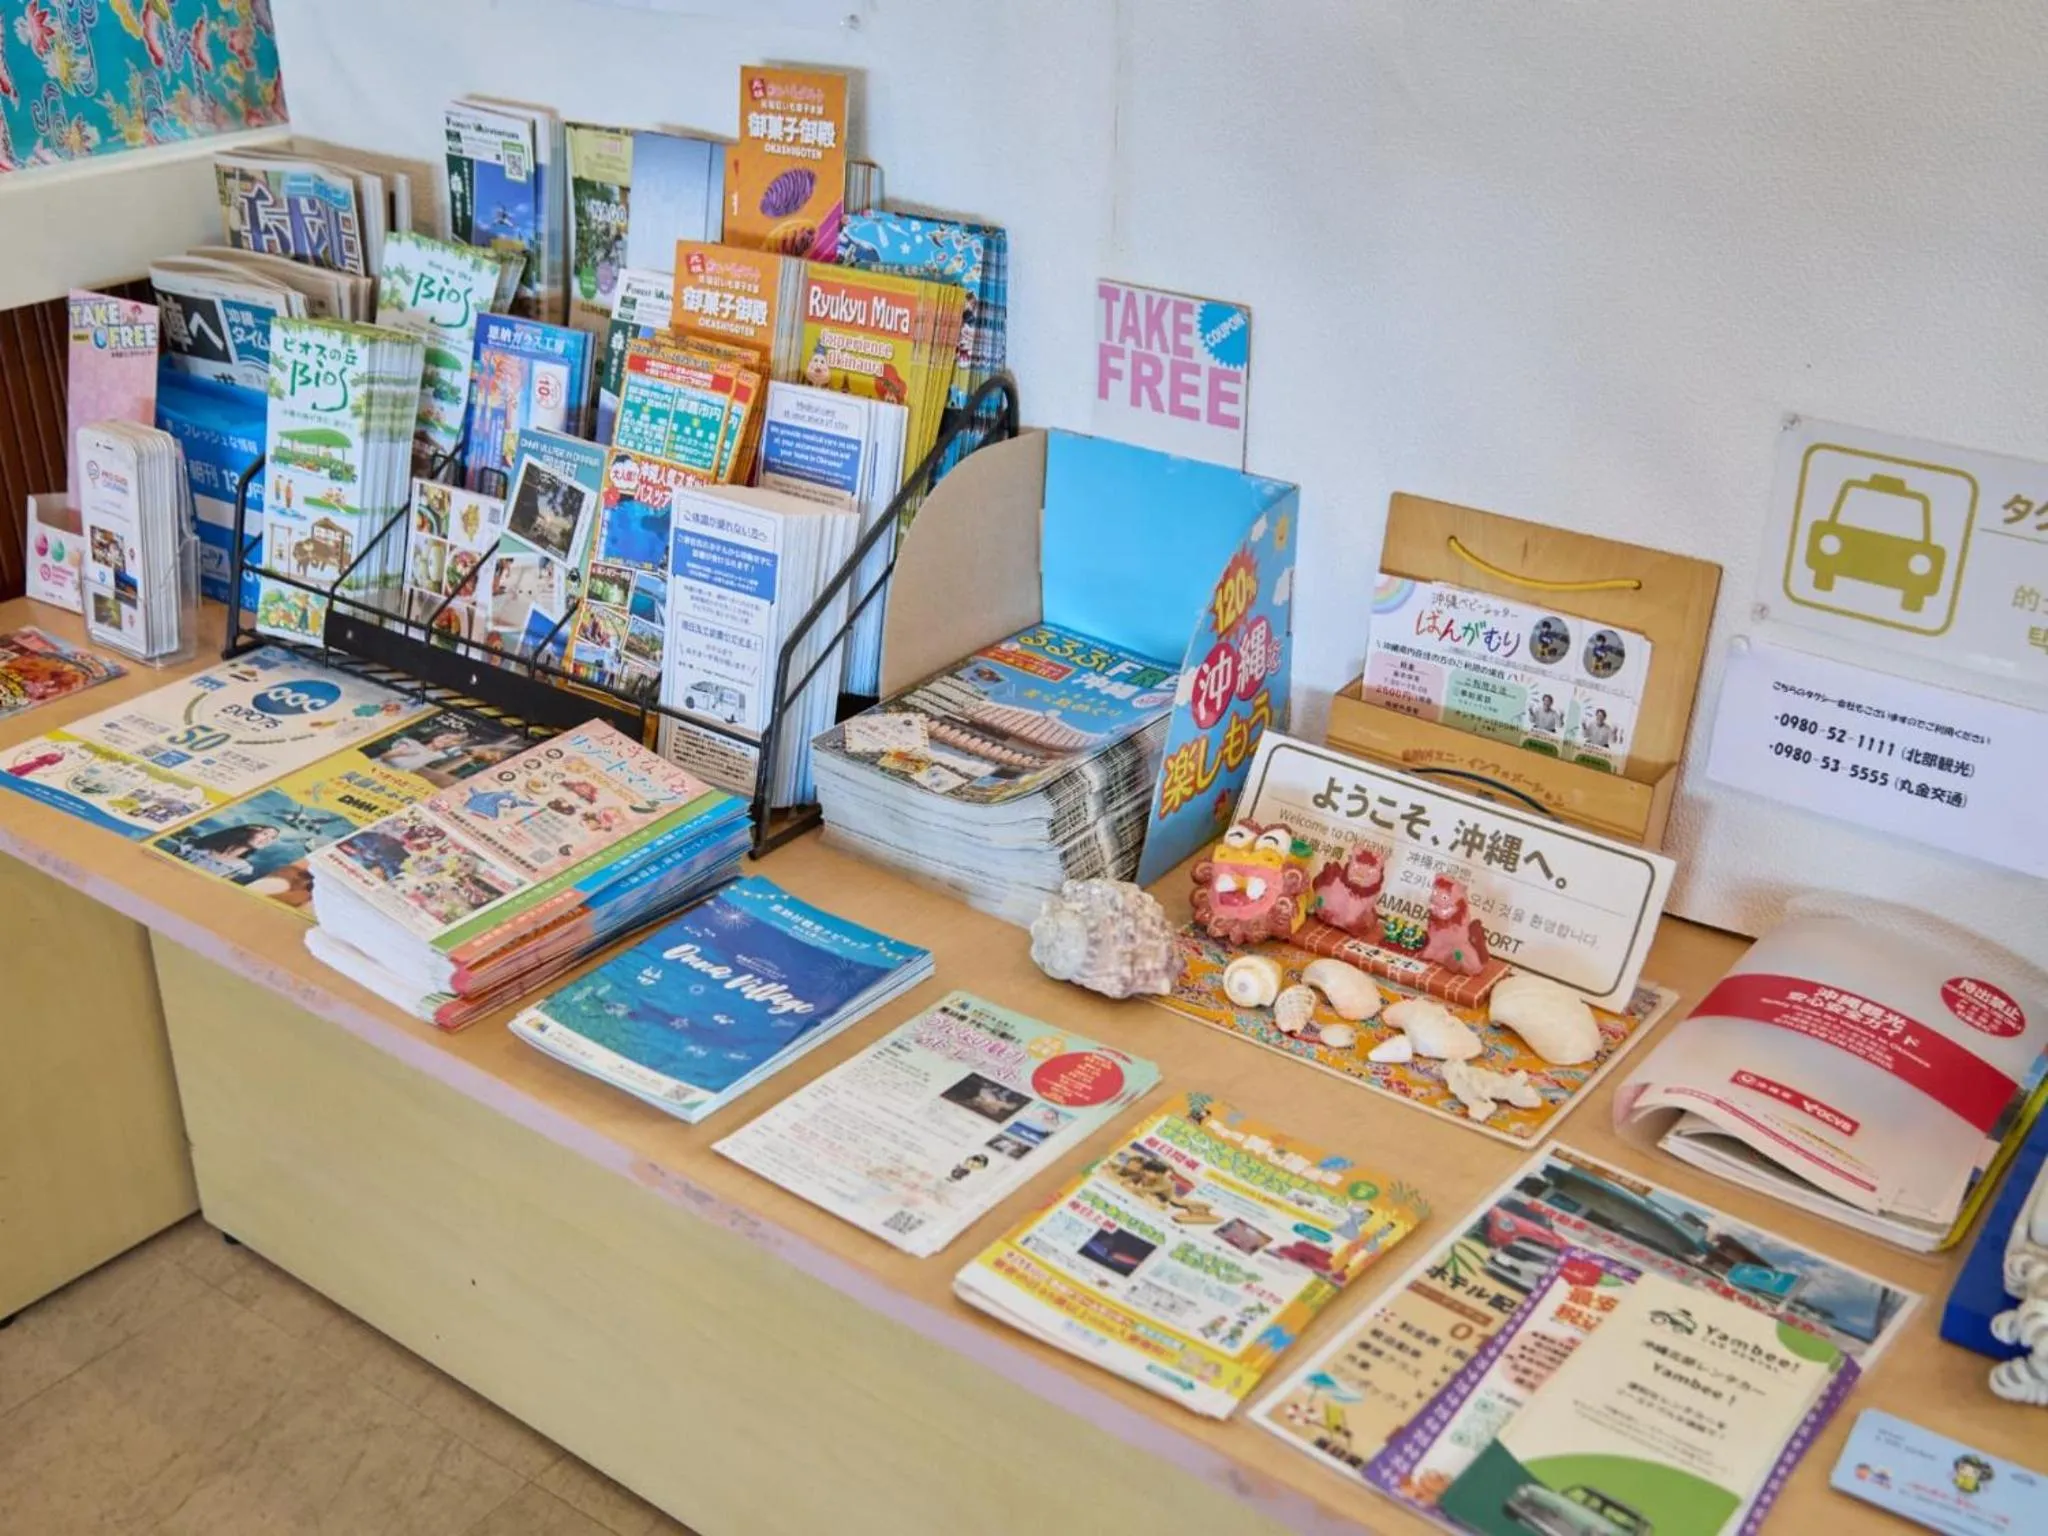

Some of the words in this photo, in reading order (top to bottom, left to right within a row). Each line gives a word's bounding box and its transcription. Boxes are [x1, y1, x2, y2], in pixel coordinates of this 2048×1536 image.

[69, 301, 121, 328] TAKE
[808, 285, 867, 326] Ryukyu
[870, 295, 911, 334] Mura
[1098, 283, 1195, 360] TAKE
[1205, 311, 1247, 347] COUPON
[108, 323, 158, 349] FREE
[283, 336, 359, 366] ビオスの丘
[1097, 342, 1242, 430] FREE
[2011, 584, 2048, 614] 的
[1160, 688, 1272, 819] 楽しもう
[1279, 808, 1329, 835] Welcome
[1332, 827, 1344, 839] to
[1312, 775, 1568, 890] ようこそ、沖縄へ。
[724, 972, 815, 1016] Village
